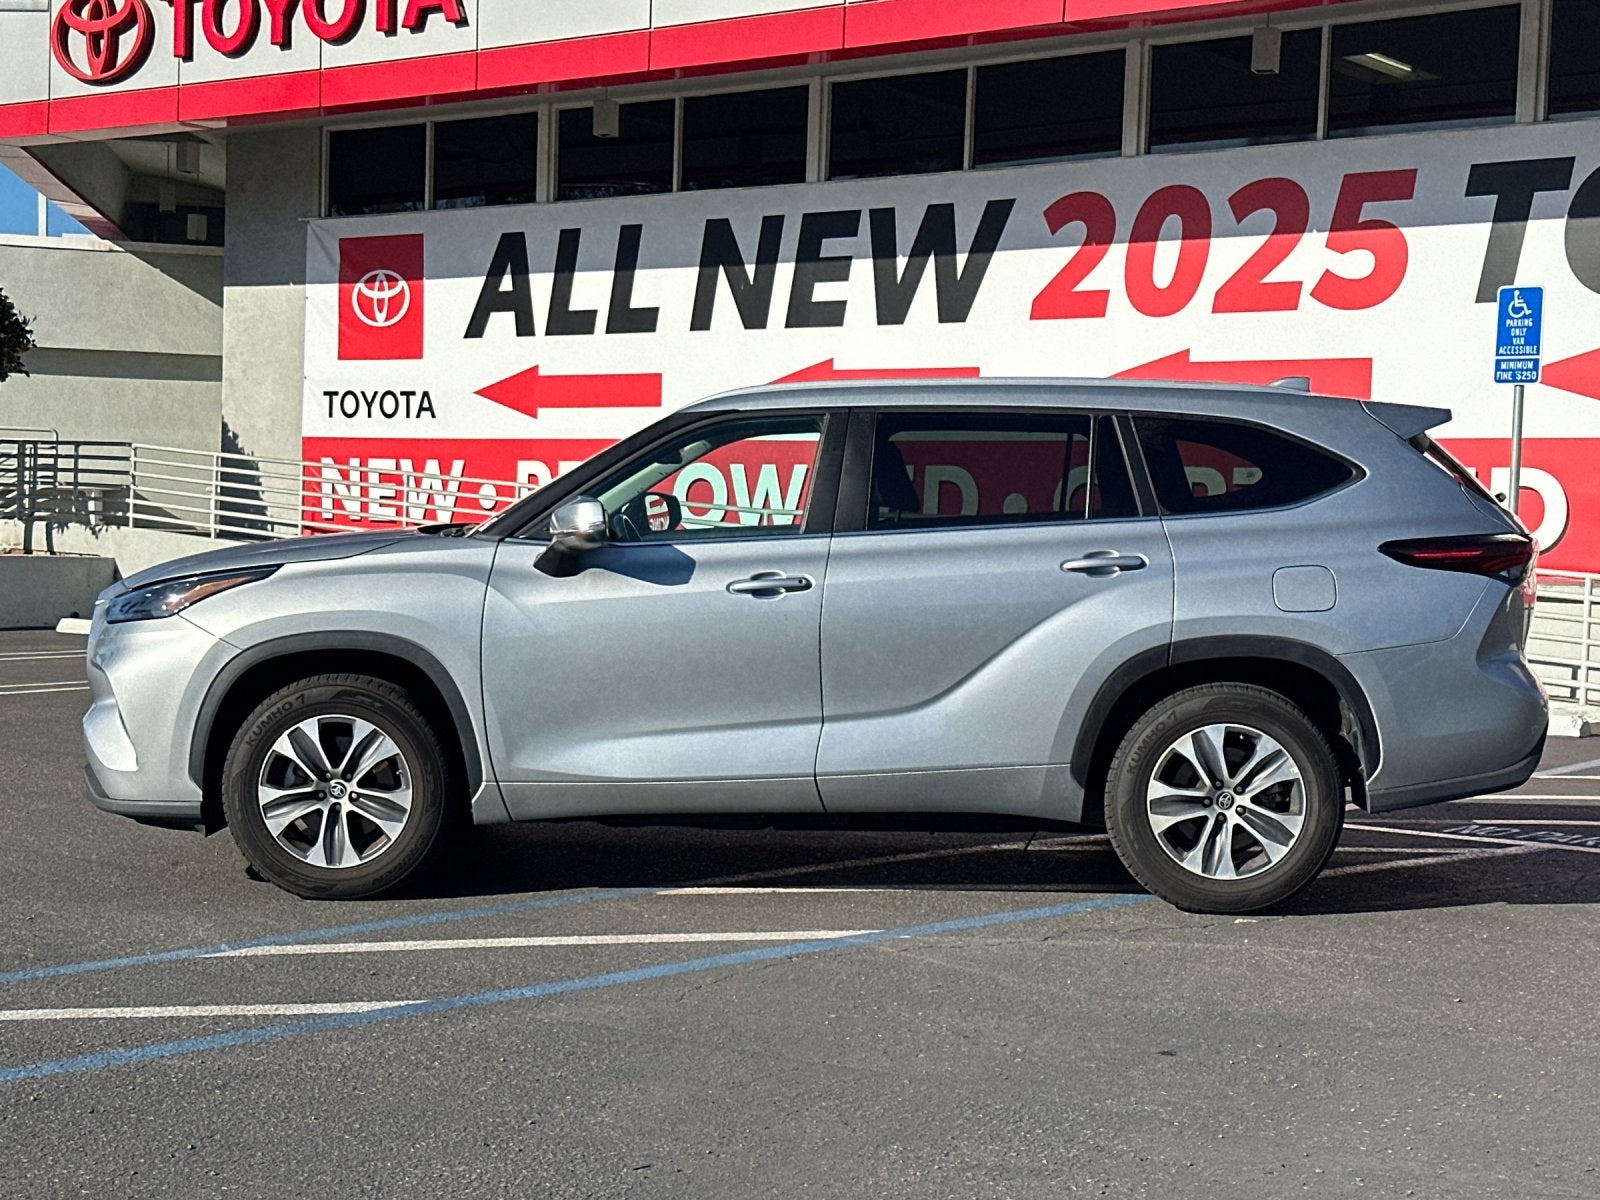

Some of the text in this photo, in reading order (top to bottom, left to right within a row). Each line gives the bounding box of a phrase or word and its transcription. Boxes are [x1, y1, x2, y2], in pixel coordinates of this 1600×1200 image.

[463, 223, 660, 339] ALL
[689, 198, 1017, 332] NEW
[1029, 168, 1418, 320] 2025
[1505, 318, 1533, 328] PARKING
[1510, 327, 1527, 337] ONLY
[1512, 337, 1525, 345] VAN
[1498, 345, 1538, 355] ACCESSIBLE
[1500, 360, 1534, 370] MINIMUM
[1496, 370, 1537, 381] FINE $250
[323, 390, 436, 420] TOYOTA
[320, 456, 465, 523] NEW
[246, 701, 293, 747] KUMHO
